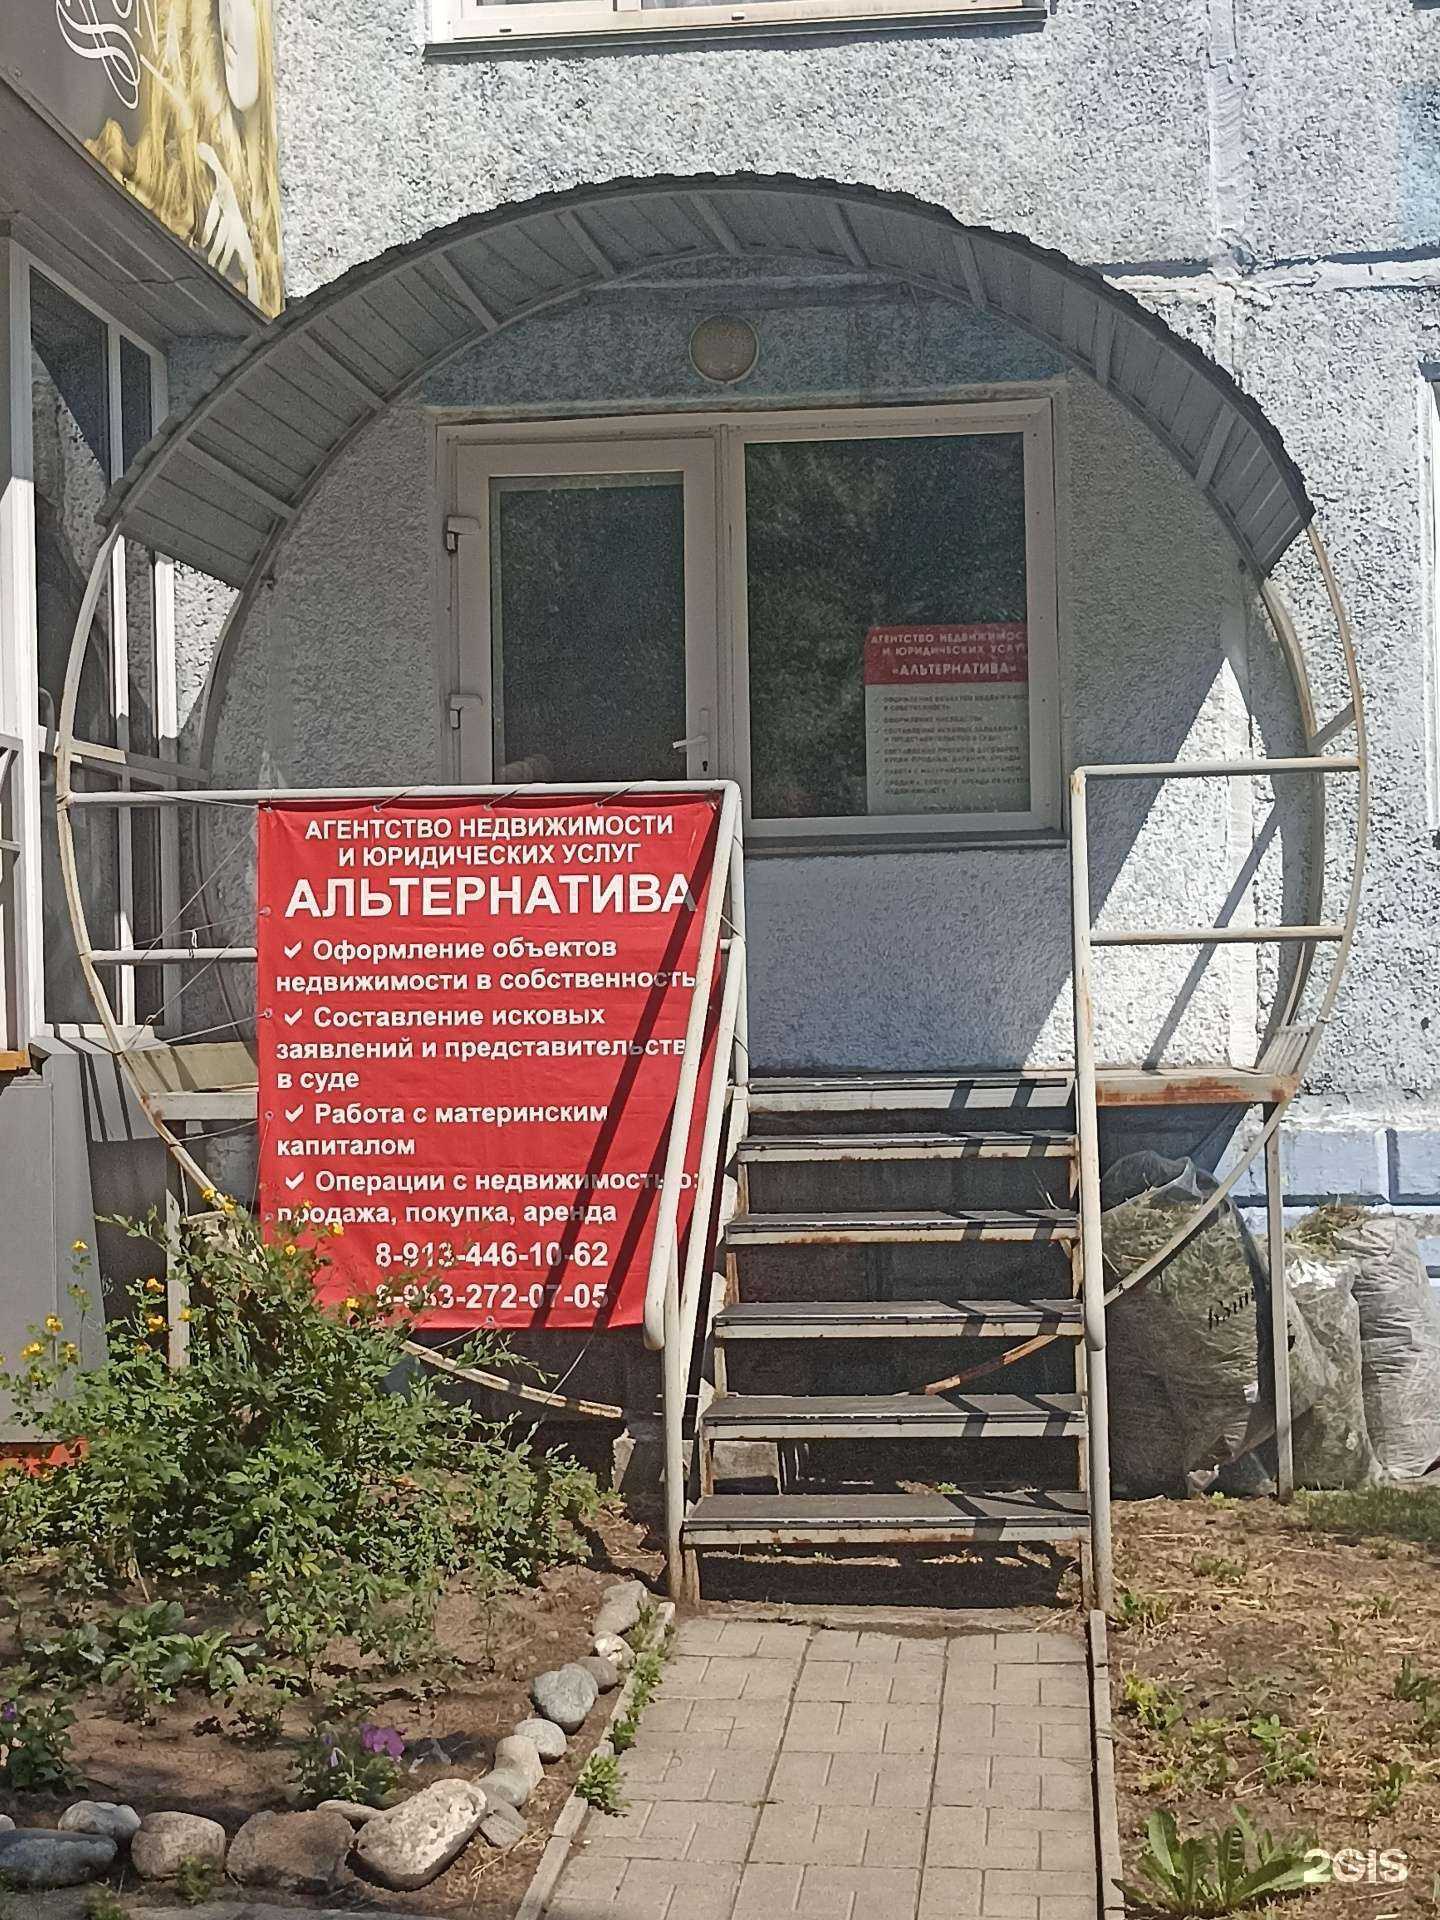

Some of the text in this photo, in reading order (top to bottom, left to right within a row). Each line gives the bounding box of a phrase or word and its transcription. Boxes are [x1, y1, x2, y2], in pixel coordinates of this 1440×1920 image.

[871, 630, 1024, 645] АГЕНТСТВО НЕДВИЖИМОС
[882, 642, 1026, 657] И ЮРИДИЧЕСКИХ УСЛУ
[305, 814, 674, 840] АГЕНТСТВО НЕДВИЖИМОСТИ
[338, 843, 641, 869] И ЮРИДИЧЕСКИХ УСЛУГ
[284, 873, 697, 918] АЛЬТЕРНАТИВА
[313, 936, 617, 965] Оформление объектов
[276, 968, 696, 994] недвижимости в собственность
[314, 1006, 605, 1027] Составление исковых
[276, 1037, 686, 1060] заявлений и представительств
[277, 1073, 360, 1093] в суде
[315, 1102, 608, 1127] Работа с материнским
[277, 1138, 415, 1156] капиталом
[315, 1170, 445, 1195] Операции
[452, 1174, 468, 1191] с
[405, 1206, 515, 1228] покупка,
[523, 1205, 617, 1225] аренда
[375, 1241, 609, 1267] 8-913-446-10-62
